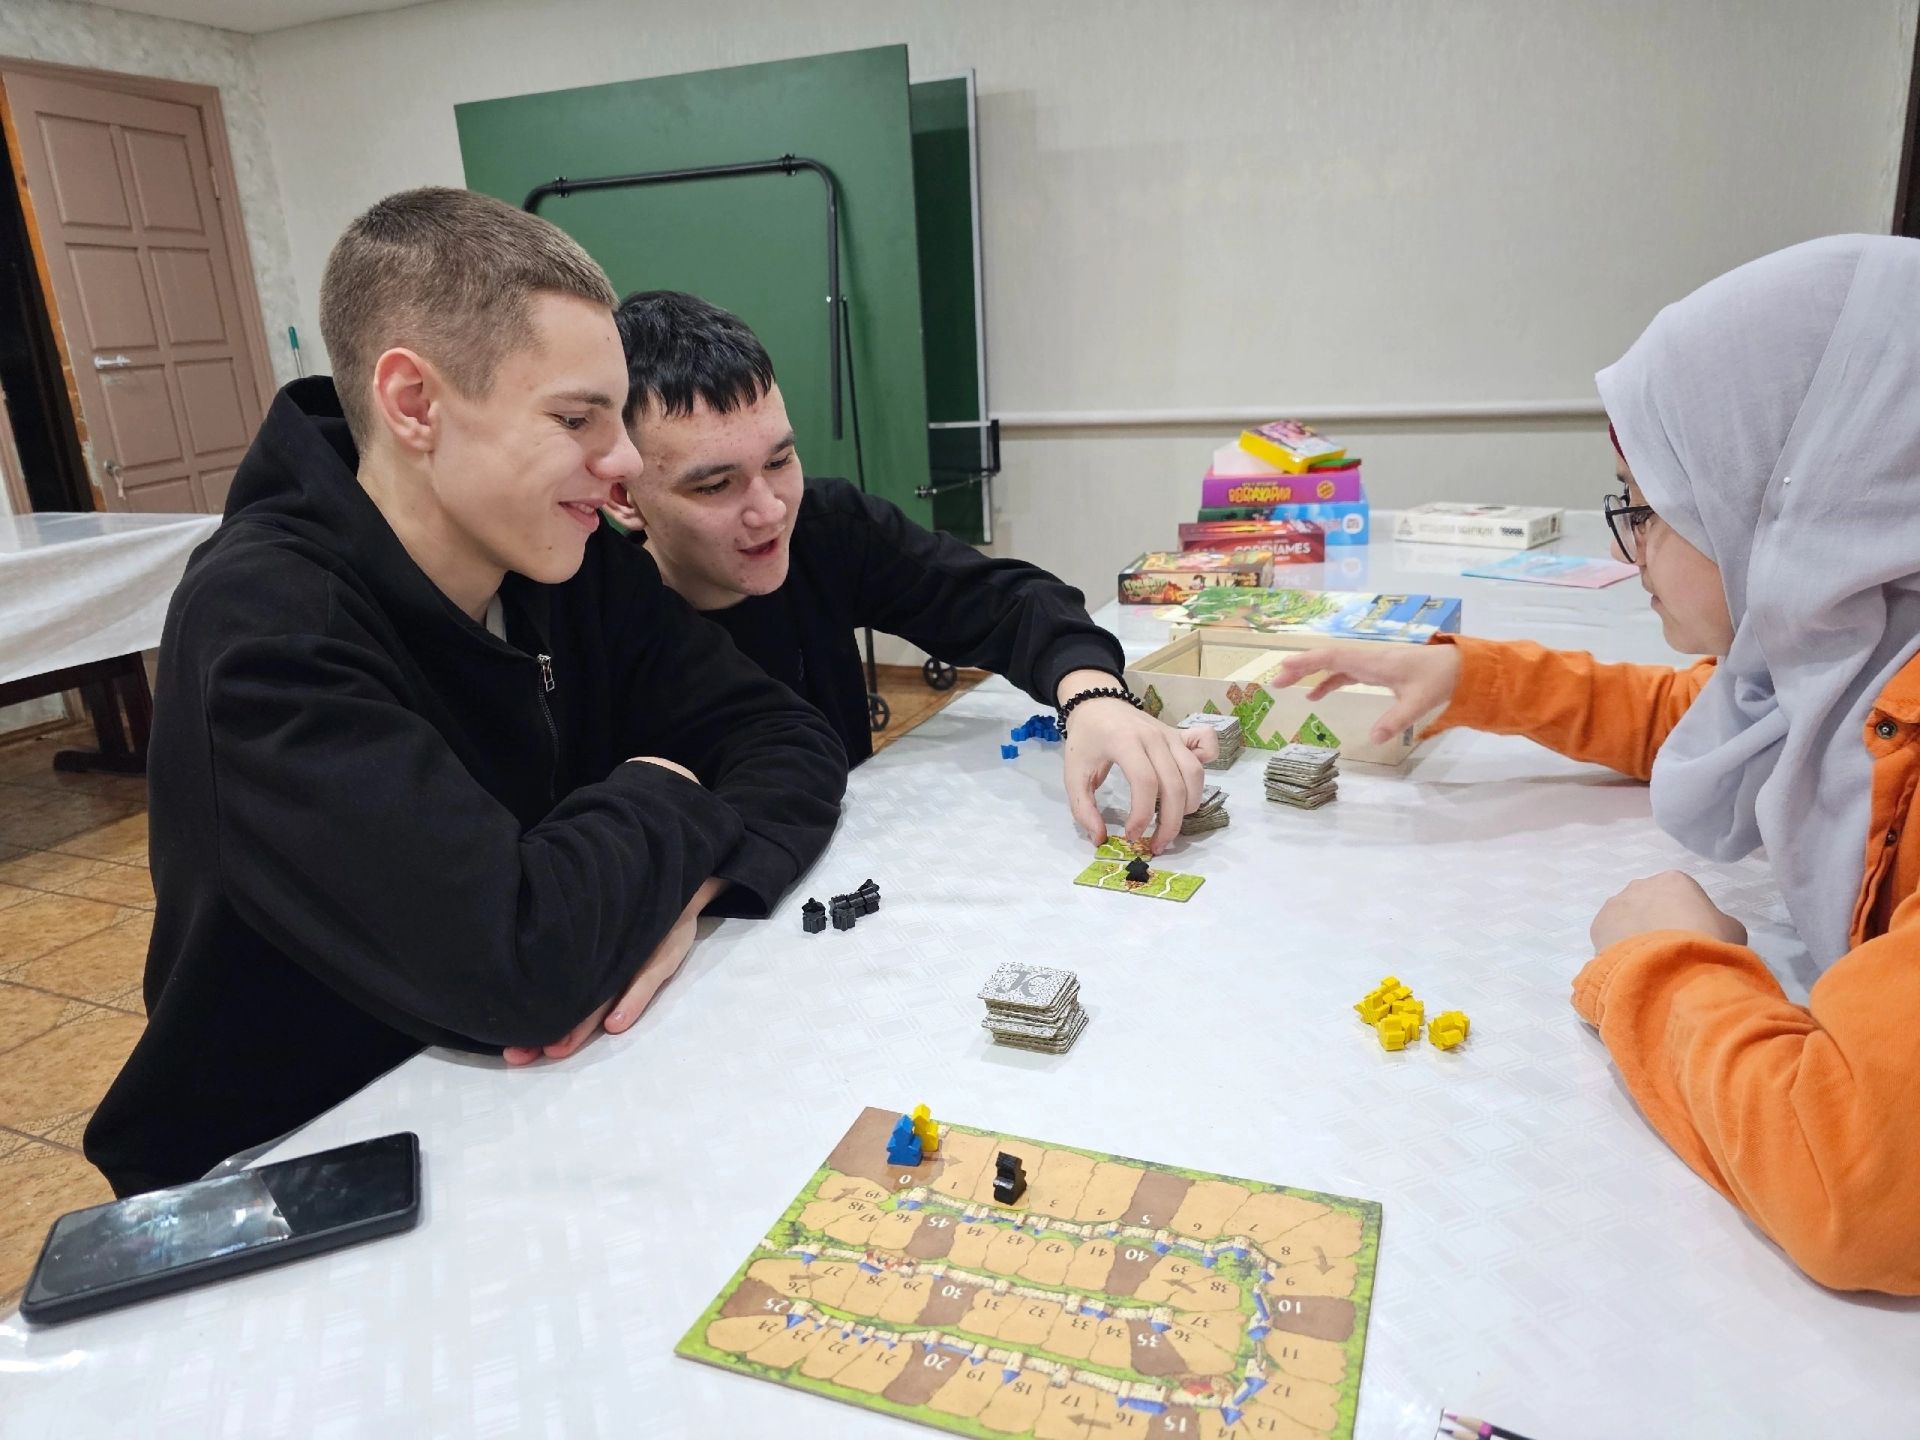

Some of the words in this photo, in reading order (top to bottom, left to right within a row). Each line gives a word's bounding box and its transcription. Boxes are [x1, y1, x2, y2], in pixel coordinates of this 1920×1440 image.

[899, 1175, 911, 1184] 0
[865, 1191, 881, 1199] 49
[848, 1202, 865, 1211] 48
[1050, 1199, 1058, 1207] 3
[859, 1214, 877, 1222] 47
[896, 1213, 912, 1223] 46
[927, 1216, 949, 1228] 45
[1141, 1214, 1152, 1224] 5
[967, 1226, 985, 1236] 44
[1193, 1223, 1202, 1231] 6
[1007, 1234, 1025, 1245] 43
[1046, 1243, 1064, 1253] 42
[1090, 1246, 1107, 1257] 41
[1281, 1246, 1291, 1255] 8
[1125, 1249, 1149, 1261] 40
[823, 1266, 843, 1276] 27
[1171, 1265, 1190, 1274] 39
[867, 1275, 887, 1286] 28
[904, 1280, 923, 1291] 29
[1286, 1277, 1295, 1285] 9
[788, 1281, 806, 1293] 26
[941, 1285, 964, 1299] 30
[1210, 1282, 1230, 1293] 38
[764, 1297, 788, 1312] 25
[984, 1299, 1000, 1308] 31
[1278, 1300, 1301, 1314] 10
[1028, 1306, 1047, 1317] 32
[758, 1320, 778, 1332] 24
[1071, 1319, 1090, 1330] 33
[1191, 1317, 1209, 1328] 37
[792, 1330, 813, 1342] 23
[1105, 1325, 1124, 1337] 34
[1174, 1330, 1192, 1342] 36
[1137, 1333, 1160, 1347] 35
[828, 1341, 848, 1354] 22
[1282, 1347, 1299, 1359] 11
[876, 1352, 896, 1364] 21
[924, 1354, 951, 1370] 20
[966, 1369, 984, 1381] 19
[1014, 1382, 1032, 1395] 18
[1273, 1385, 1291, 1397] 12
[1061, 1395, 1080, 1407] 17
[1116, 1412, 1134, 1425] 16
[1164, 1416, 1187, 1433] 15
[1258, 1418, 1275, 1431] 13
